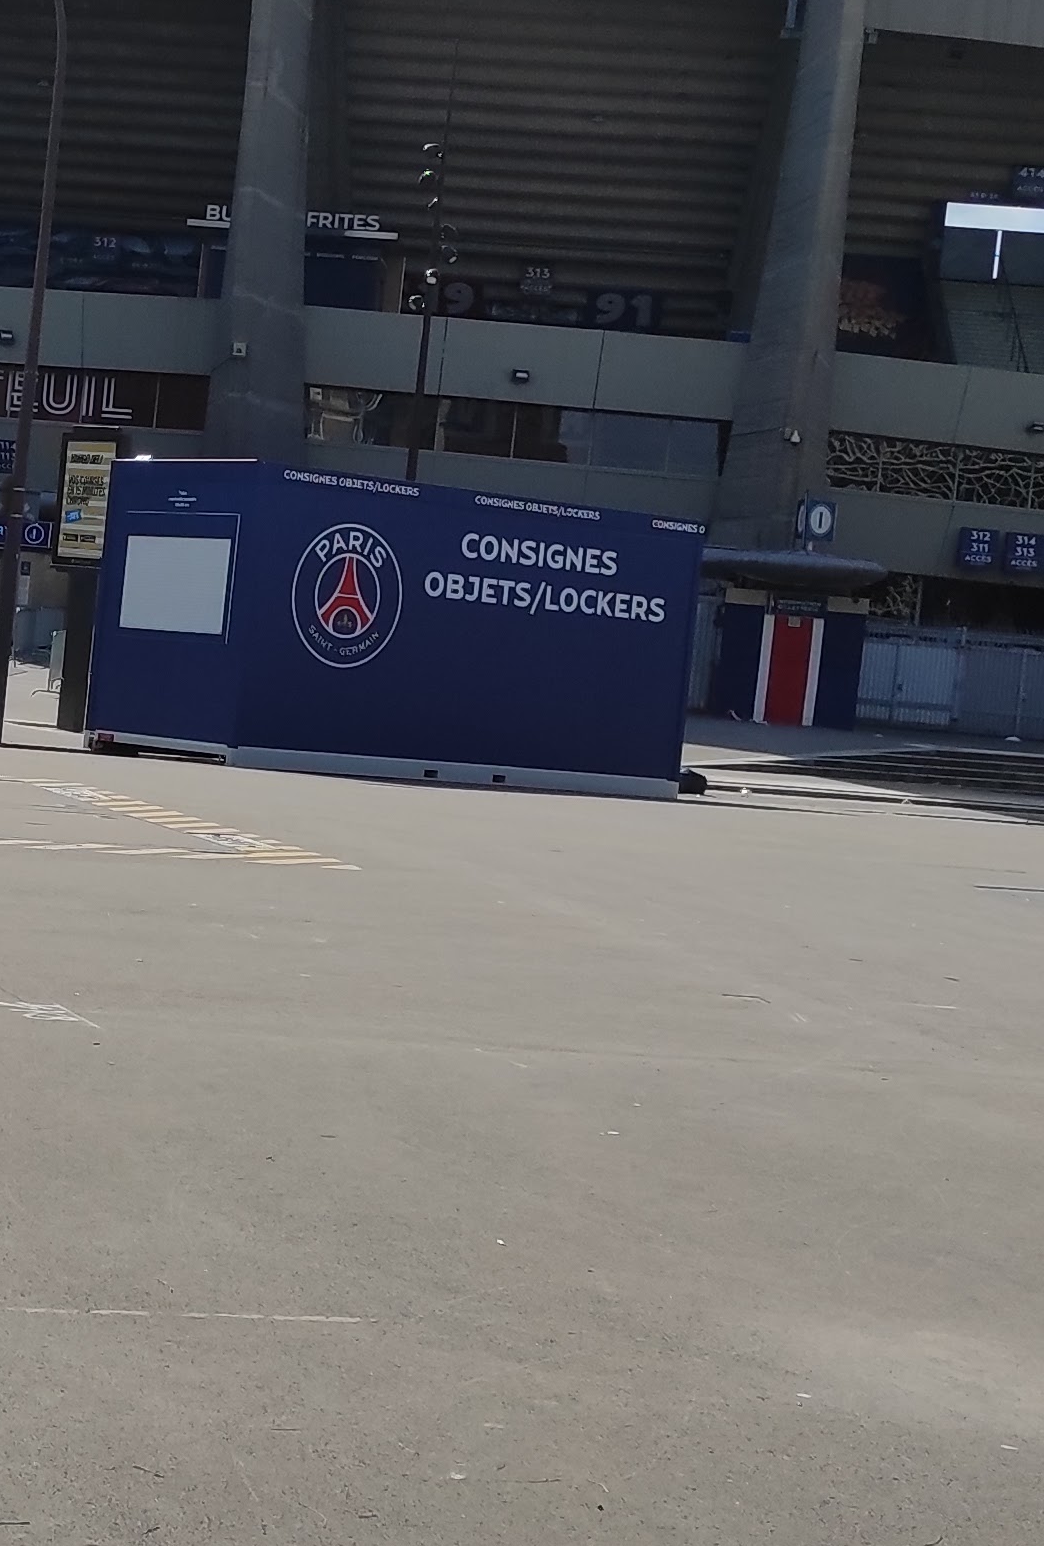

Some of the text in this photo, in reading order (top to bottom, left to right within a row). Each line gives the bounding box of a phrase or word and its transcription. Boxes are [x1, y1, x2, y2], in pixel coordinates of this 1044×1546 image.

[306, 211, 380, 232] FRITES
[93, 236, 116, 248] 312
[525, 267, 550, 279] 313
[596, 293, 653, 327] 91
[283, 469, 420, 497] CONSIGNES OBJETS/LOCKERS
[475, 495, 601, 520] CONSIGNES OBJETS/LOCKERS
[652, 519, 698, 533] CONSIGNES
[970, 530, 991, 541] 312
[315, 531, 387, 568] PARIS
[970, 542, 989, 552] 311
[1015, 534, 1036, 546] 314
[460, 532, 618, 576] CONSIGNES
[1014, 546, 1035, 557] 313
[424, 570, 666, 623] OBJETS/LOCKERS
[308, 624, 333, 652] SAINT
[339, 631, 380, 657] GERMAIN
